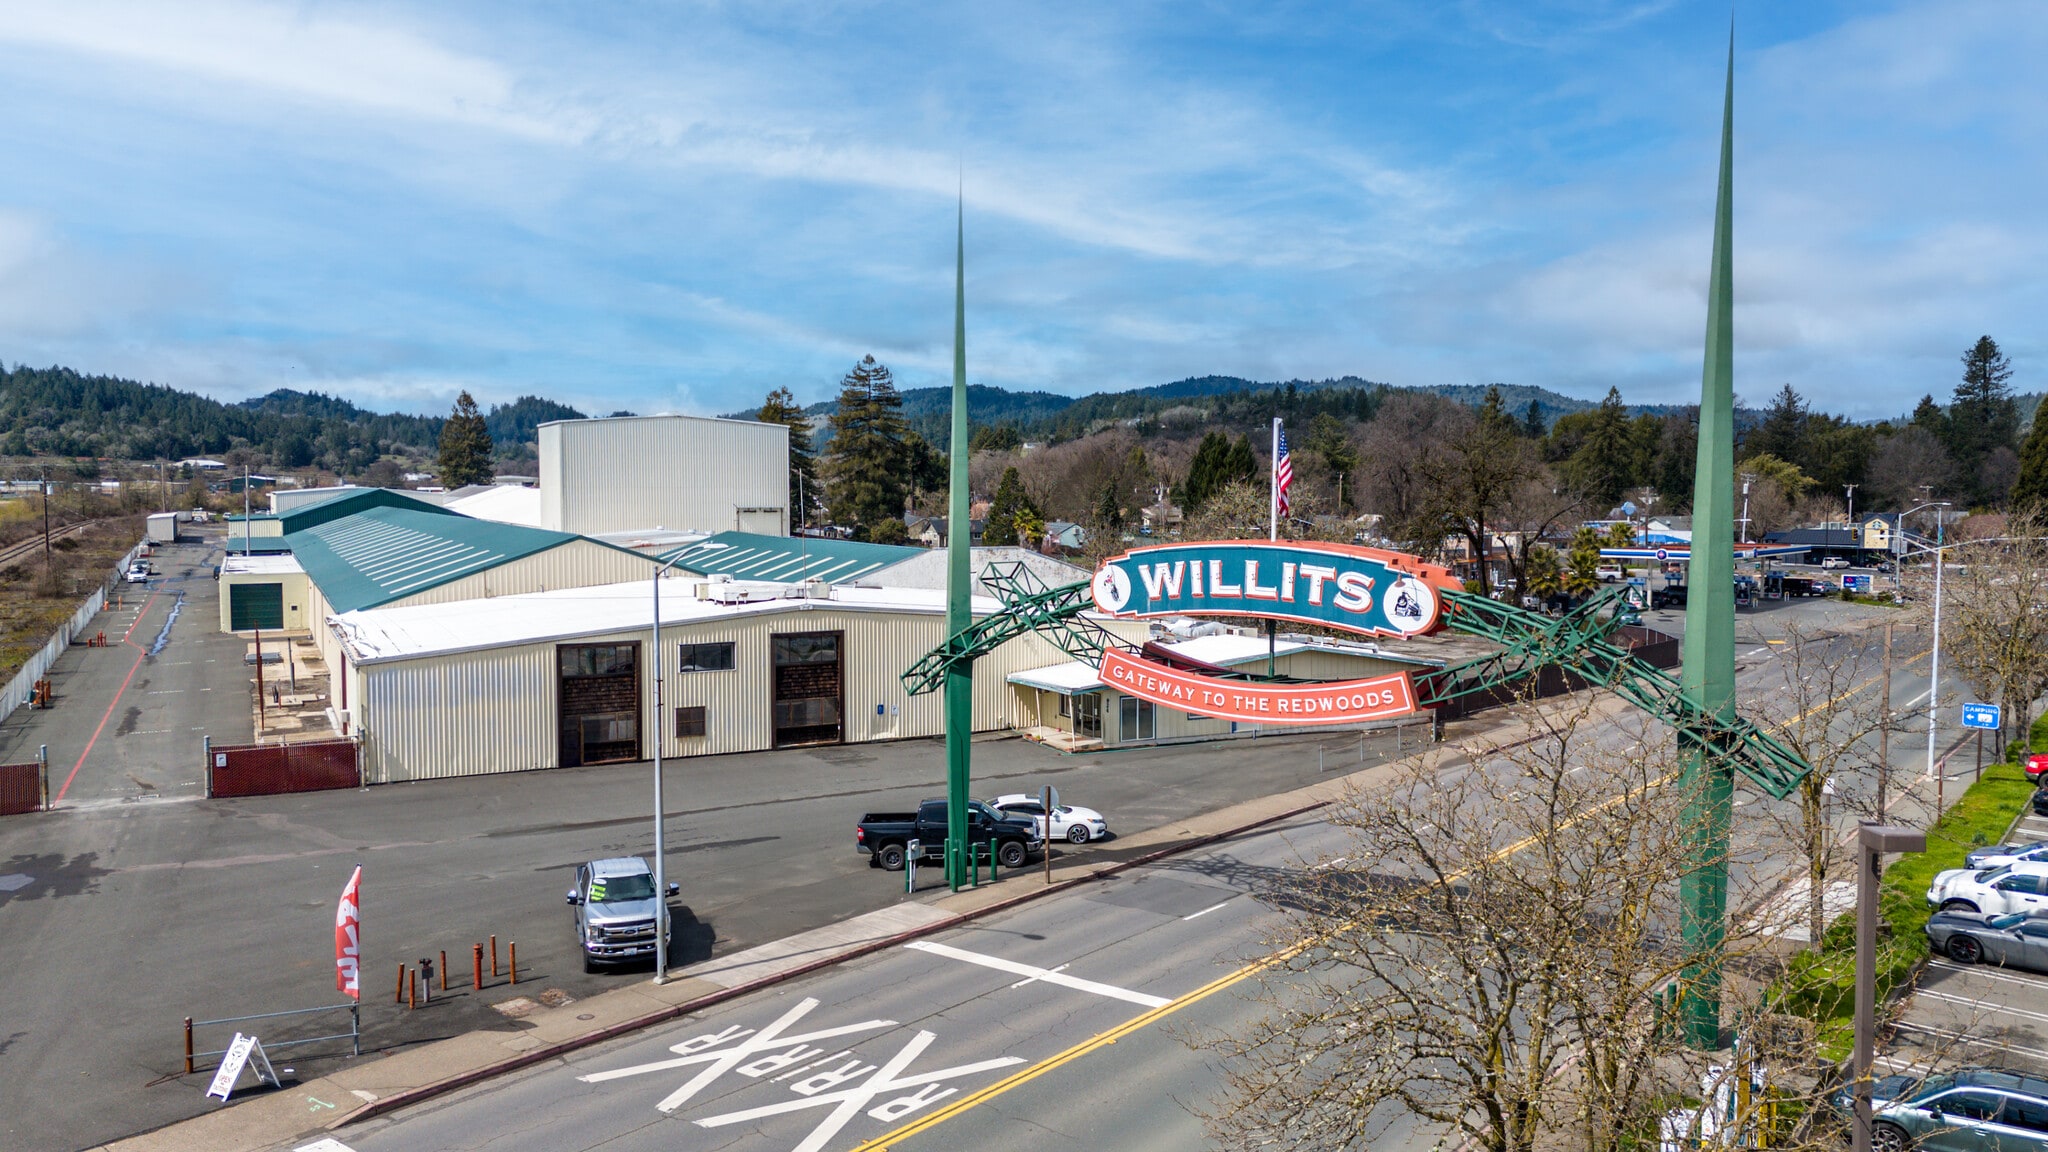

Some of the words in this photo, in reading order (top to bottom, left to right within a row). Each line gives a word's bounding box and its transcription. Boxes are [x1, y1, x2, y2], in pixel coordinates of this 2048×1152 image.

[1138, 559, 1375, 613] WILLITS
[1113, 665, 1196, 701] GATEWAY
[1203, 691, 1226, 707] TO
[1233, 695, 1269, 712] THE
[1277, 689, 1395, 713] REDWOODS
[1965, 706, 1998, 714] CAMPING
[669, 1024, 756, 1056] R
[736, 1044, 824, 1078] R
[790, 1059, 878, 1096] R
[867, 1083, 959, 1122] R
